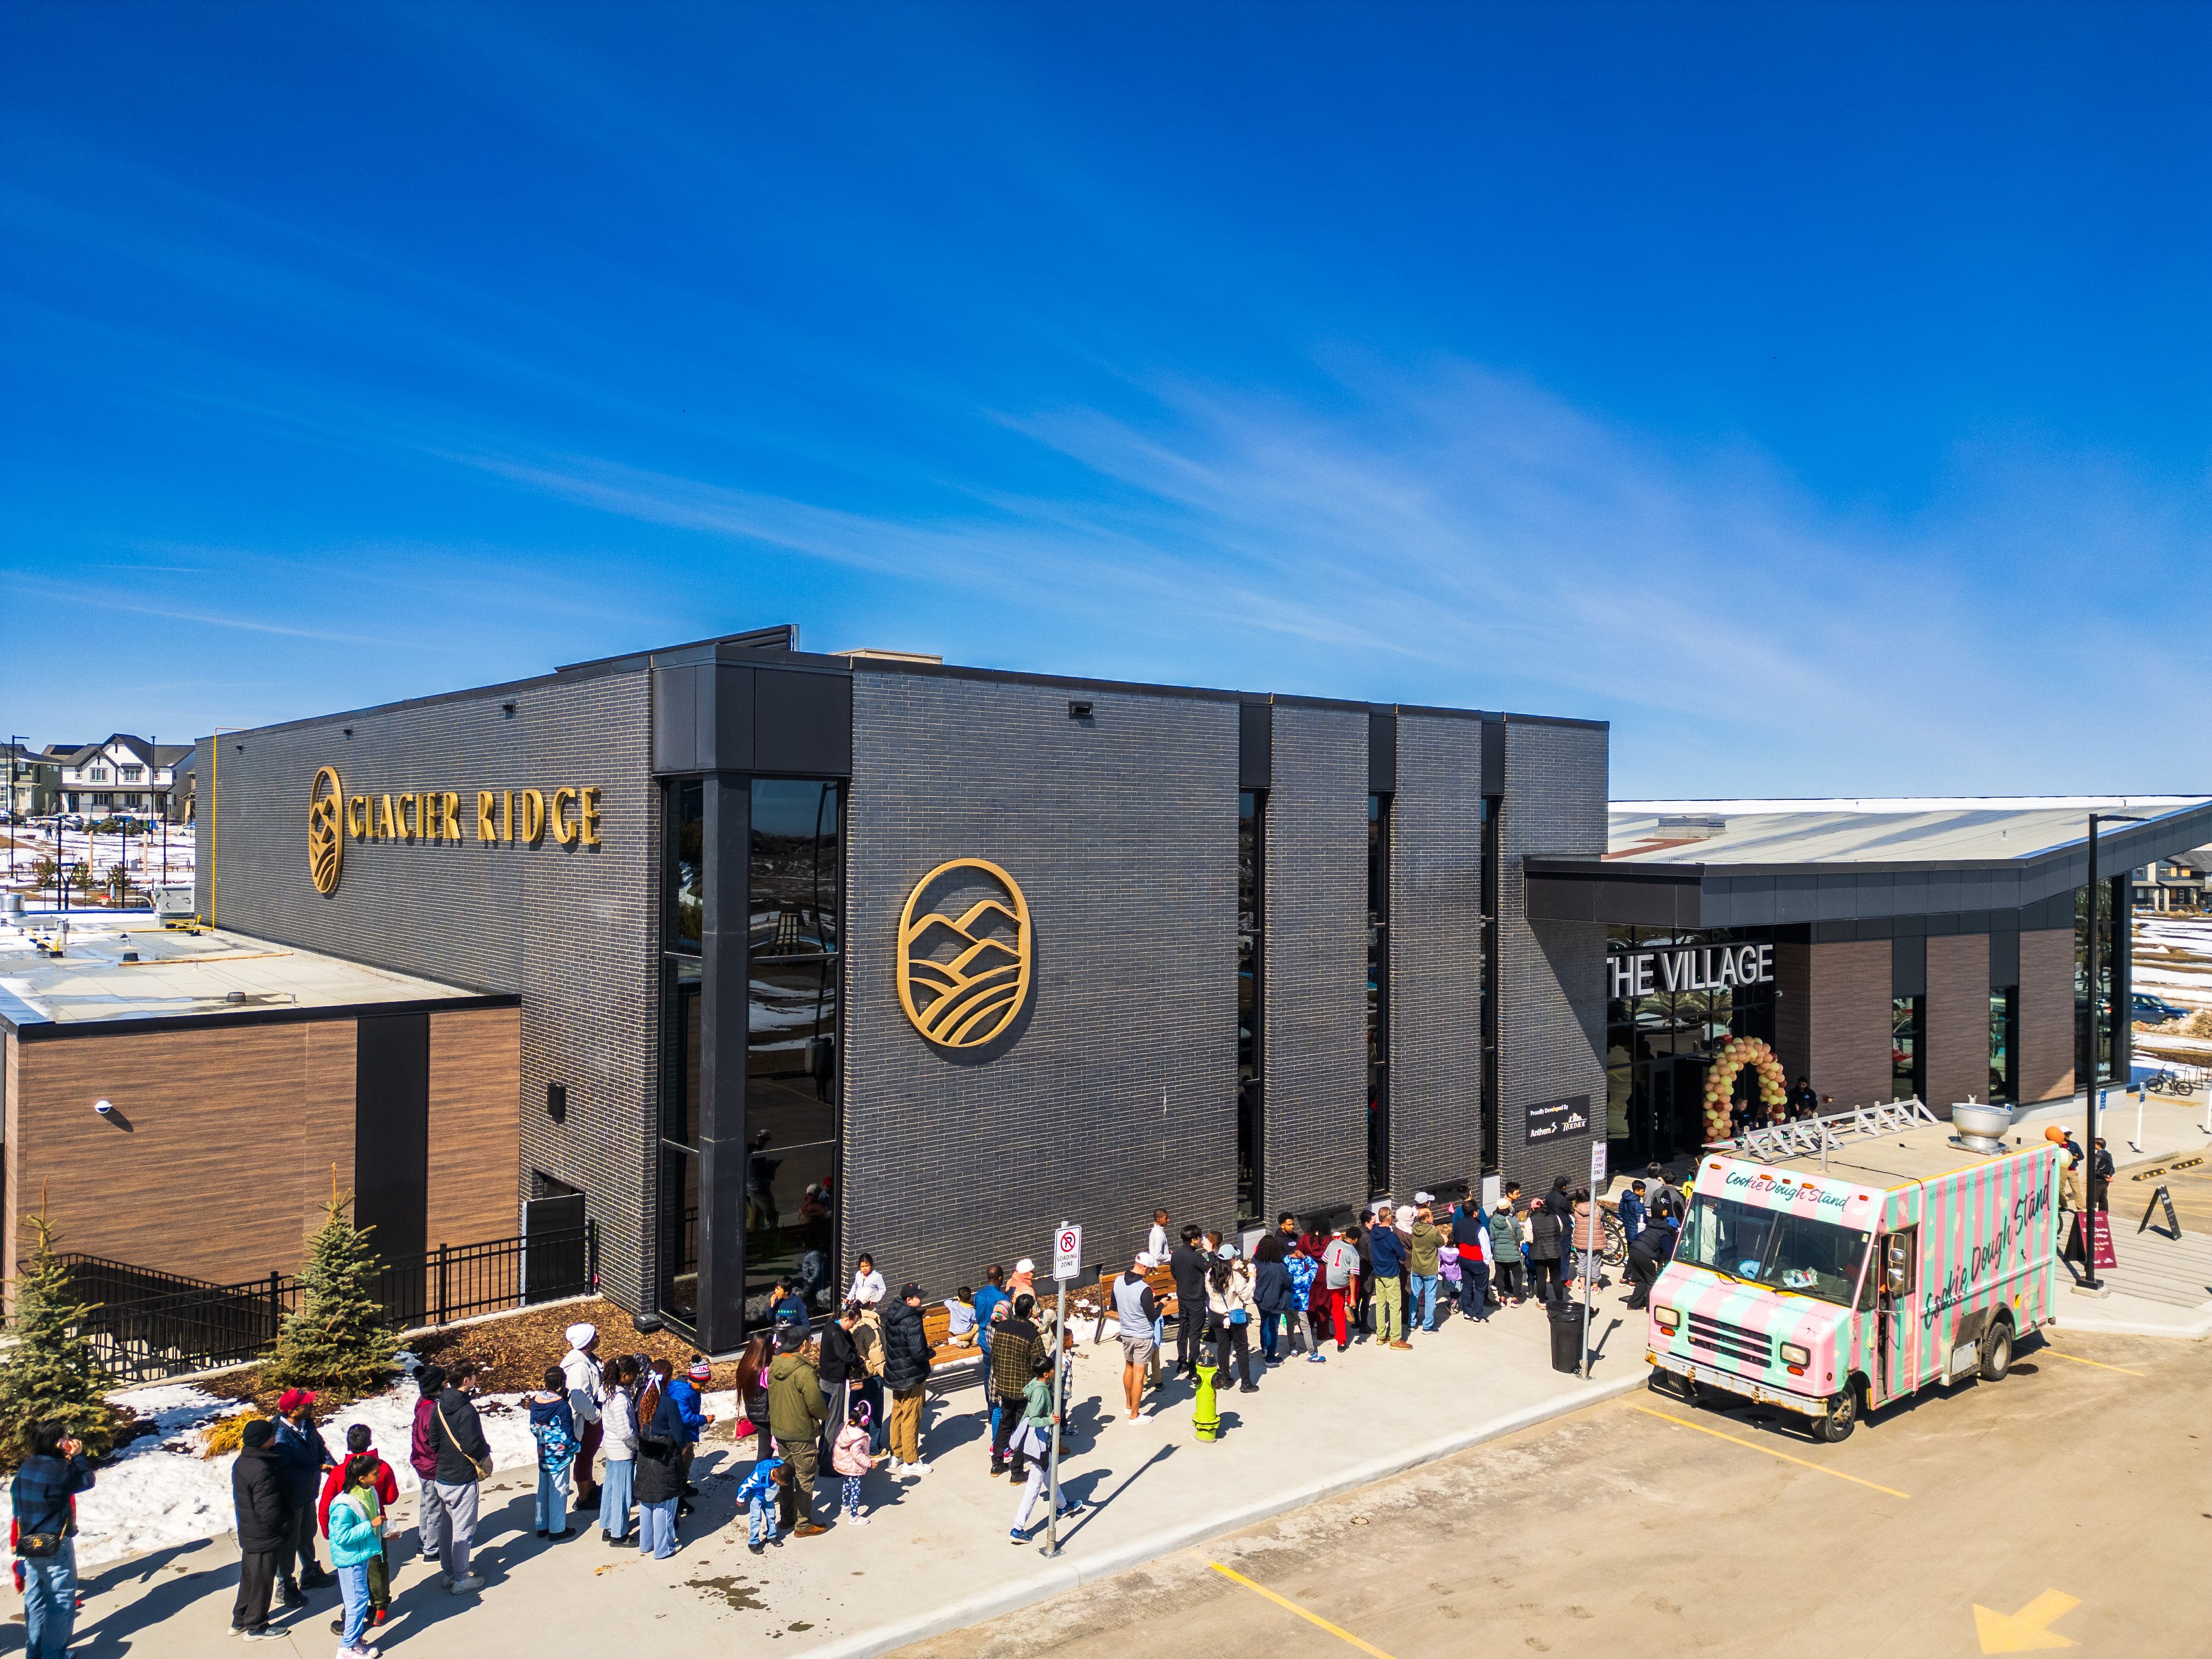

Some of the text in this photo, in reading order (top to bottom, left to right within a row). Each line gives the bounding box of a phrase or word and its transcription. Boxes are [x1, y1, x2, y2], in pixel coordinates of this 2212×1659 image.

[348, 787, 600, 844] GLACIER RIDGE
[1607, 944, 1774, 998] HE VILLAGE
[1530, 1108, 1544, 1116] Proudly
[1544, 1104, 1564, 1113] Developed
[1530, 1127, 1551, 1137] Anthem
[1725, 1171, 1851, 1212] Cookie Dough Stand
[1943, 1186, 1956, 1197] cookie
[1957, 1181, 1970, 1193] dough
[1057, 1253, 1077, 1262] LOADING
[1334, 1248, 1343, 1268] 1
[1924, 1170, 2051, 1330] Cookie Dough Stand
[1718, 1288, 1743, 1296] gourmet
[1743, 1293, 1769, 1304] lemonade
[1775, 1302, 1810, 1314] handcrafted
